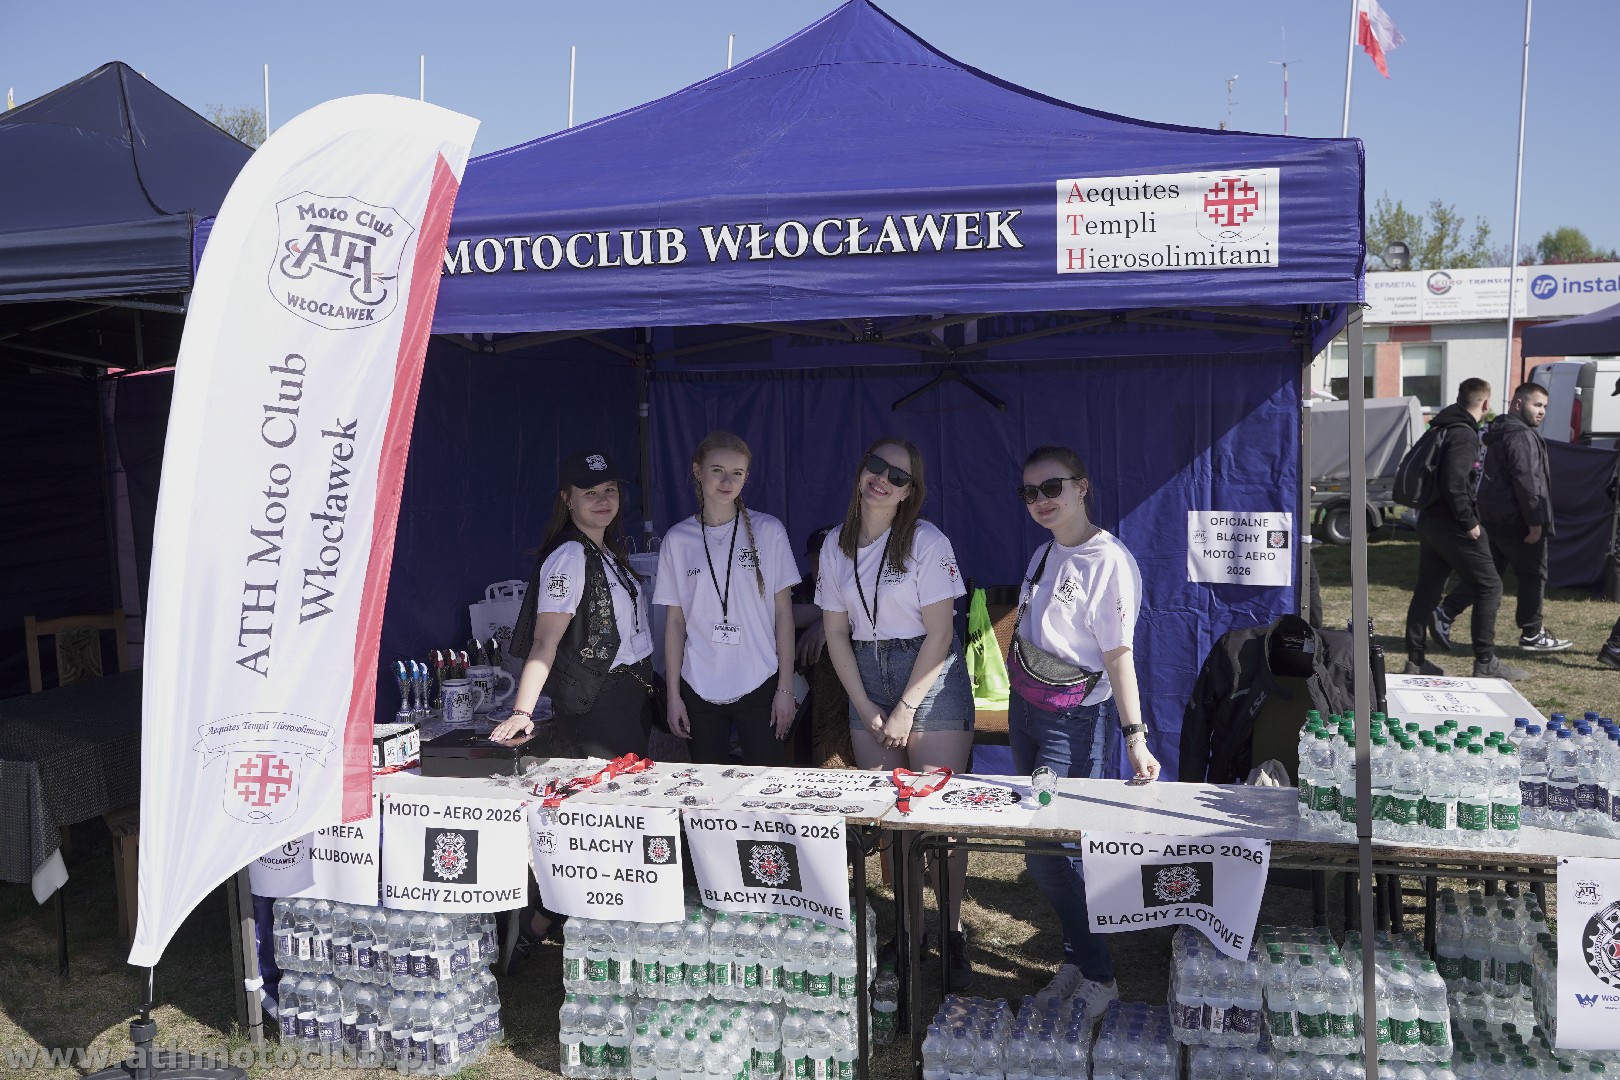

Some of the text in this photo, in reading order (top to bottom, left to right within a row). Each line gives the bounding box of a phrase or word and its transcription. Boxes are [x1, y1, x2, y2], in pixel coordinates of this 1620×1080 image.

[1066, 179, 1180, 207] Aequites
[296, 202, 394, 238] Moto Club
[1066, 211, 1157, 238] Templi
[441, 208, 1025, 277] MOTOCLUB WŁOCŁAWEK
[291, 224, 377, 293] ATH
[1066, 241, 1272, 270] Hierosolimitani
[1374, 281, 1417, 289] EFMETAL
[287, 291, 376, 321] WŁOCŁAWEK
[235, 353, 307, 678] ATH Moto Club
[299, 418, 358, 625] Włocławek
[1210, 517, 1269, 528] OFICJALNE
[1216, 532, 1260, 543] BLACHY
[1203, 549, 1235, 560] MOTO
[1245, 551, 1276, 561] AERO
[1226, 566, 1251, 576] 2026
[389, 802, 430, 817] MOTO
[443, 806, 483, 821] AERO
[486, 808, 522, 822] 2026
[558, 812, 645, 830] OFICJALNE
[690, 816, 736, 832] MOTO
[753, 820, 797, 836] AERO
[800, 825, 840, 840] 2026
[309, 847, 374, 865] KLUBOWA
[569, 837, 634, 854] BLACHY
[1089, 840, 1144, 856] MOTO
[1162, 844, 1215, 857] AERO
[1220, 845, 1264, 865] 2026
[551, 863, 598, 880] MOTO
[614, 867, 658, 884] AERO
[386, 885, 522, 903] BLACHY ZLOTOWE
[586, 891, 624, 906] 2026
[704, 889, 844, 920] BLACHY ZLOTOWE
[1096, 907, 1244, 950] BLACHY ZLOTOWE
